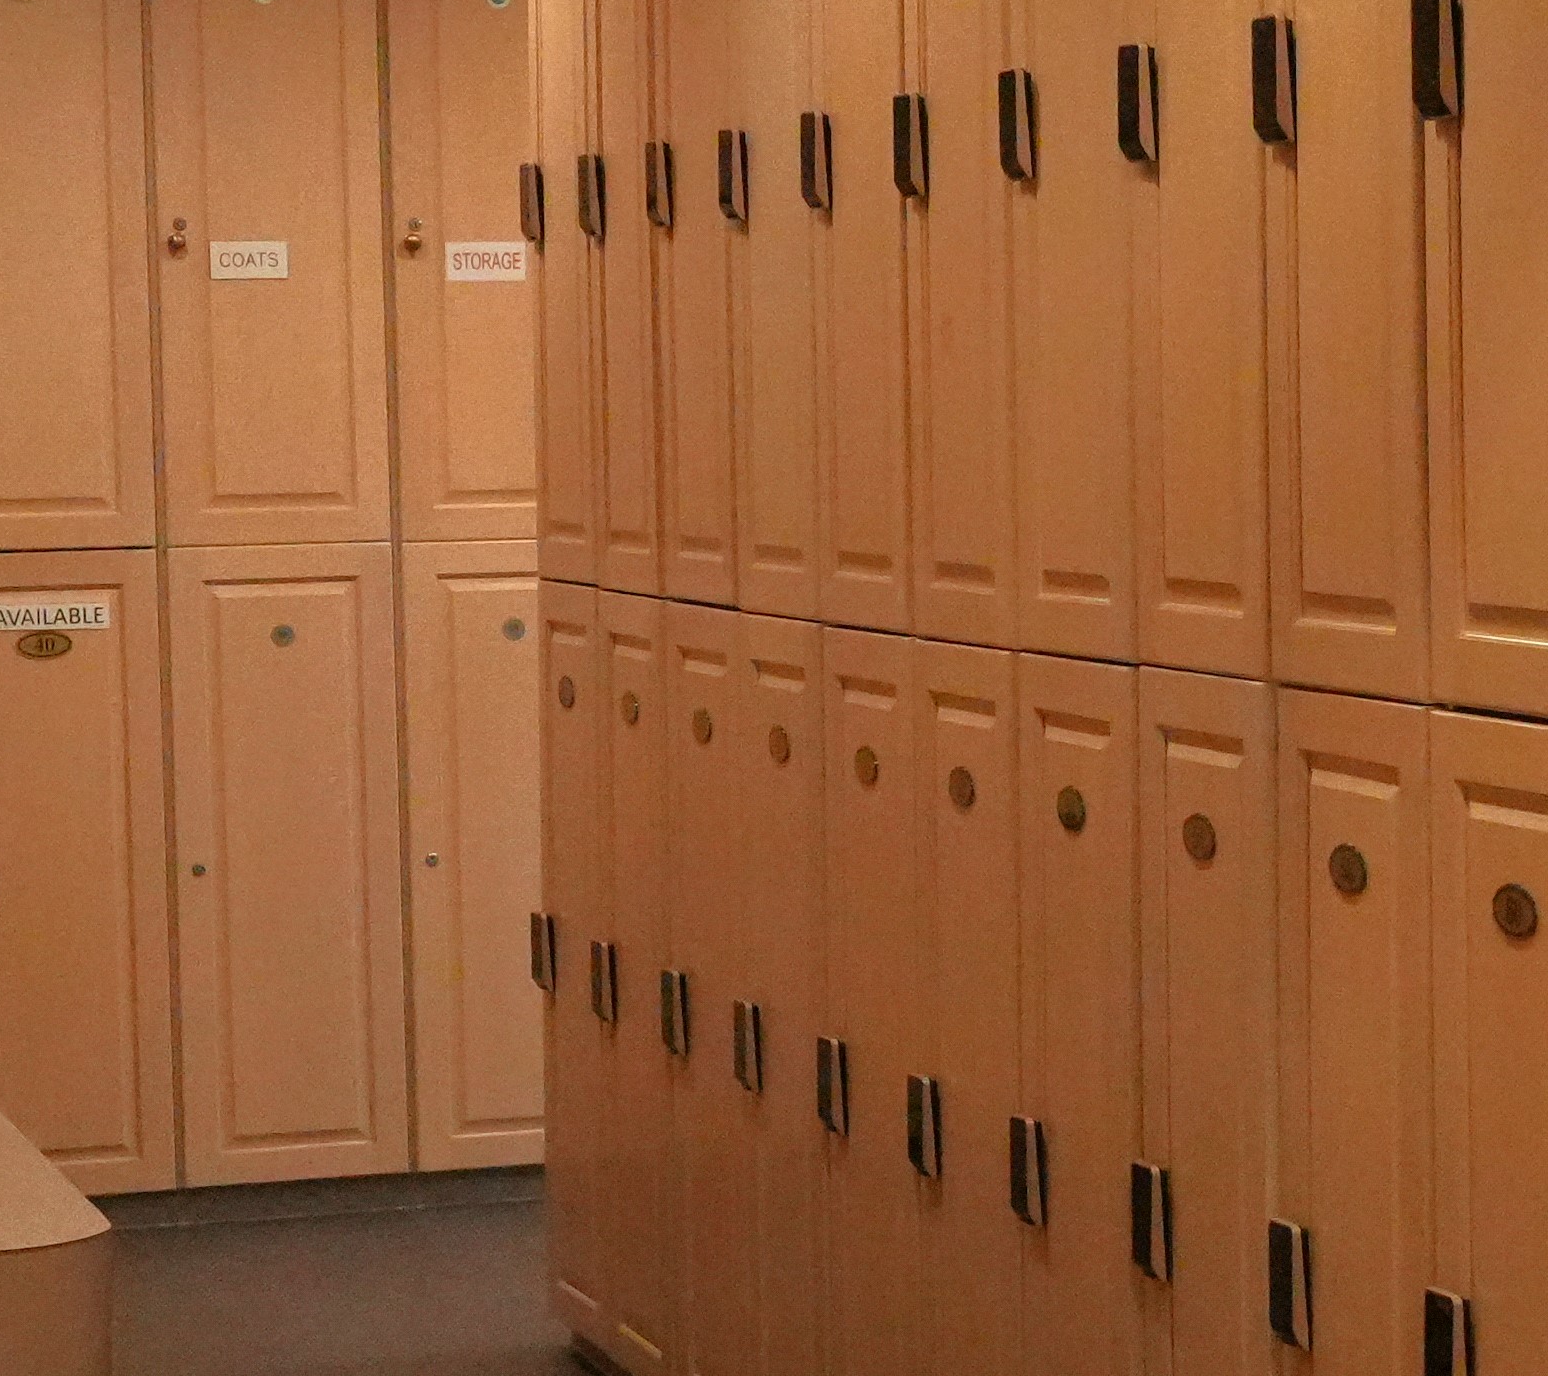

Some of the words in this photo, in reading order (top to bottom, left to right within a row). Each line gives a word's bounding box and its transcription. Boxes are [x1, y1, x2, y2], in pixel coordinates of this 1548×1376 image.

[218, 252, 279, 269] COATS
[453, 252, 522, 271] STORAGE
[35, 637, 55, 653] 40
